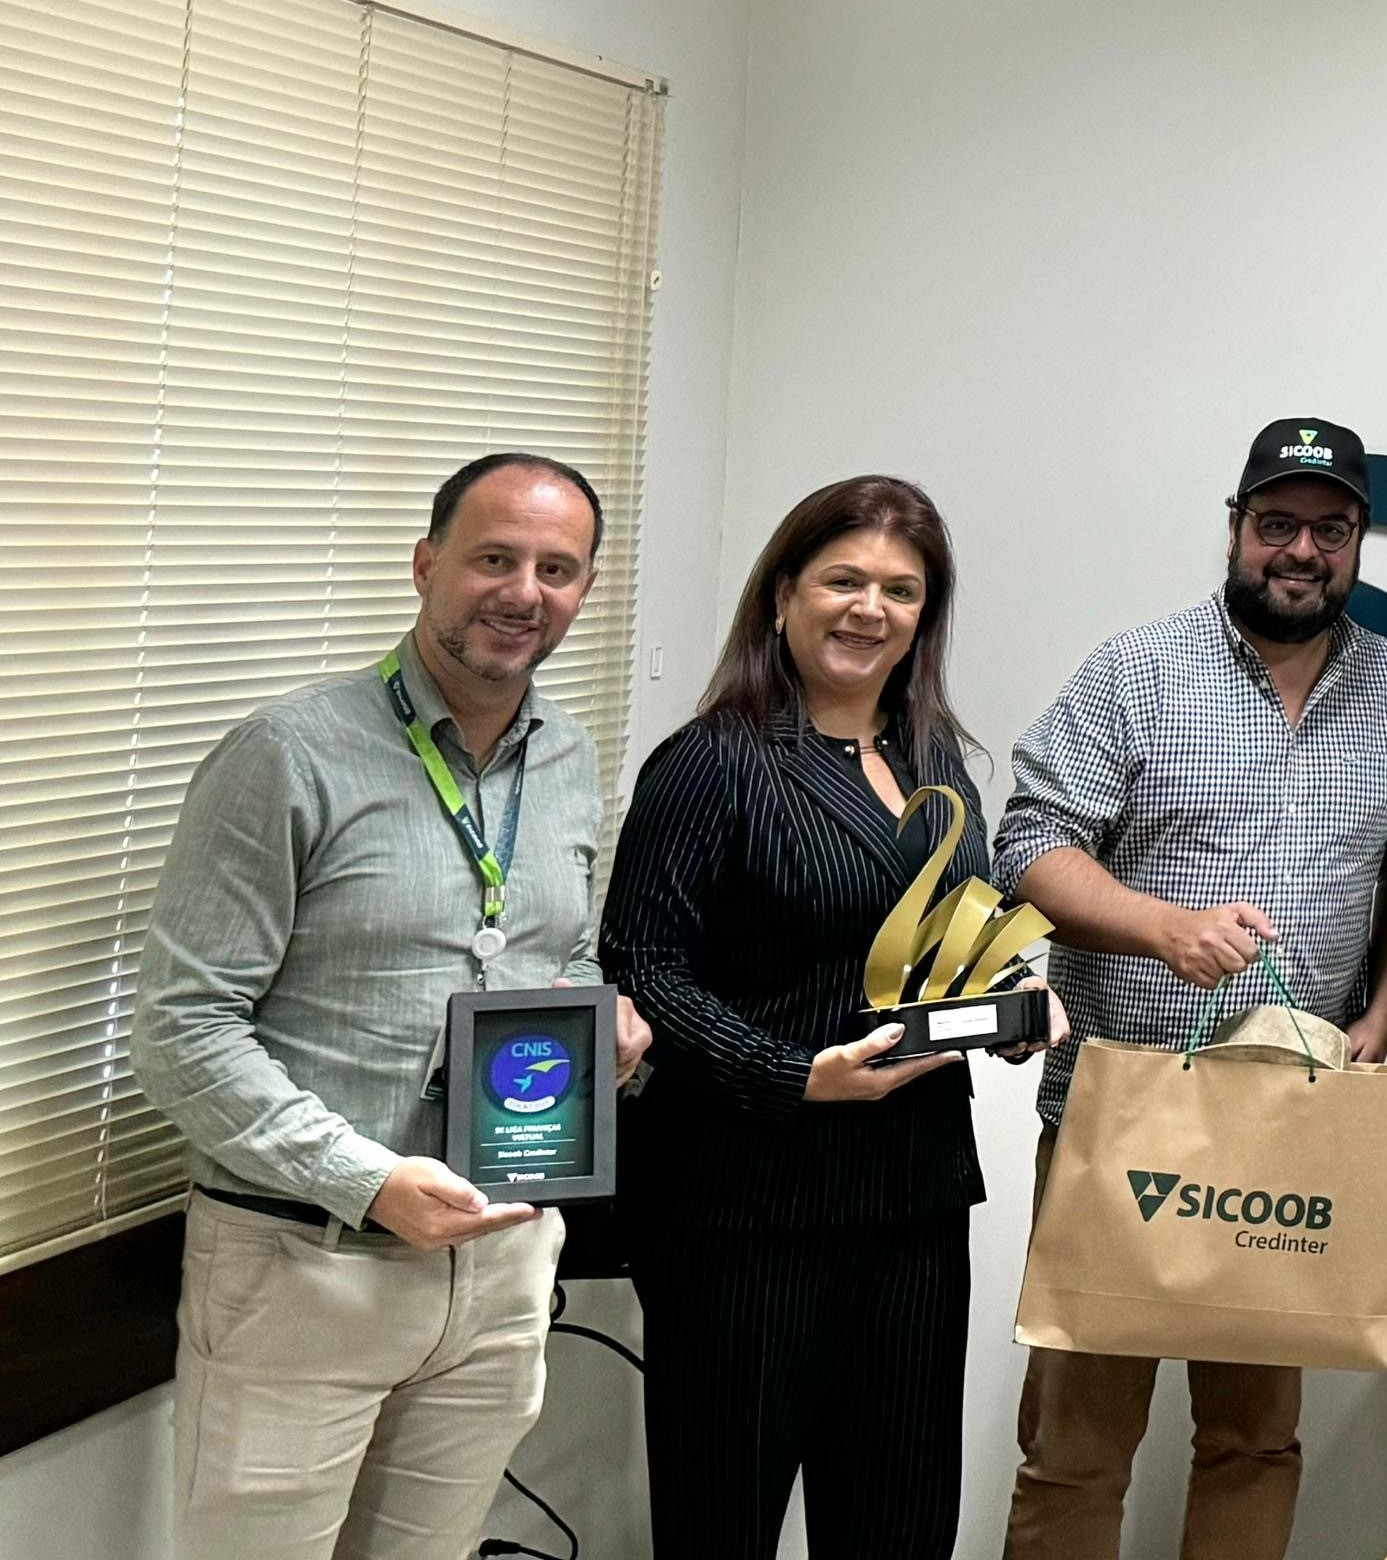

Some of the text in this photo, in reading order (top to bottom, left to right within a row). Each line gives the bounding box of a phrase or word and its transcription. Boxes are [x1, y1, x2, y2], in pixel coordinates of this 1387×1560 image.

[1279, 444, 1333, 460] SICOOB
[511, 1041, 552, 1058] CNIS
[1176, 1183, 1333, 1230] SICOOB
[1234, 1230, 1328, 1255] Credinter
